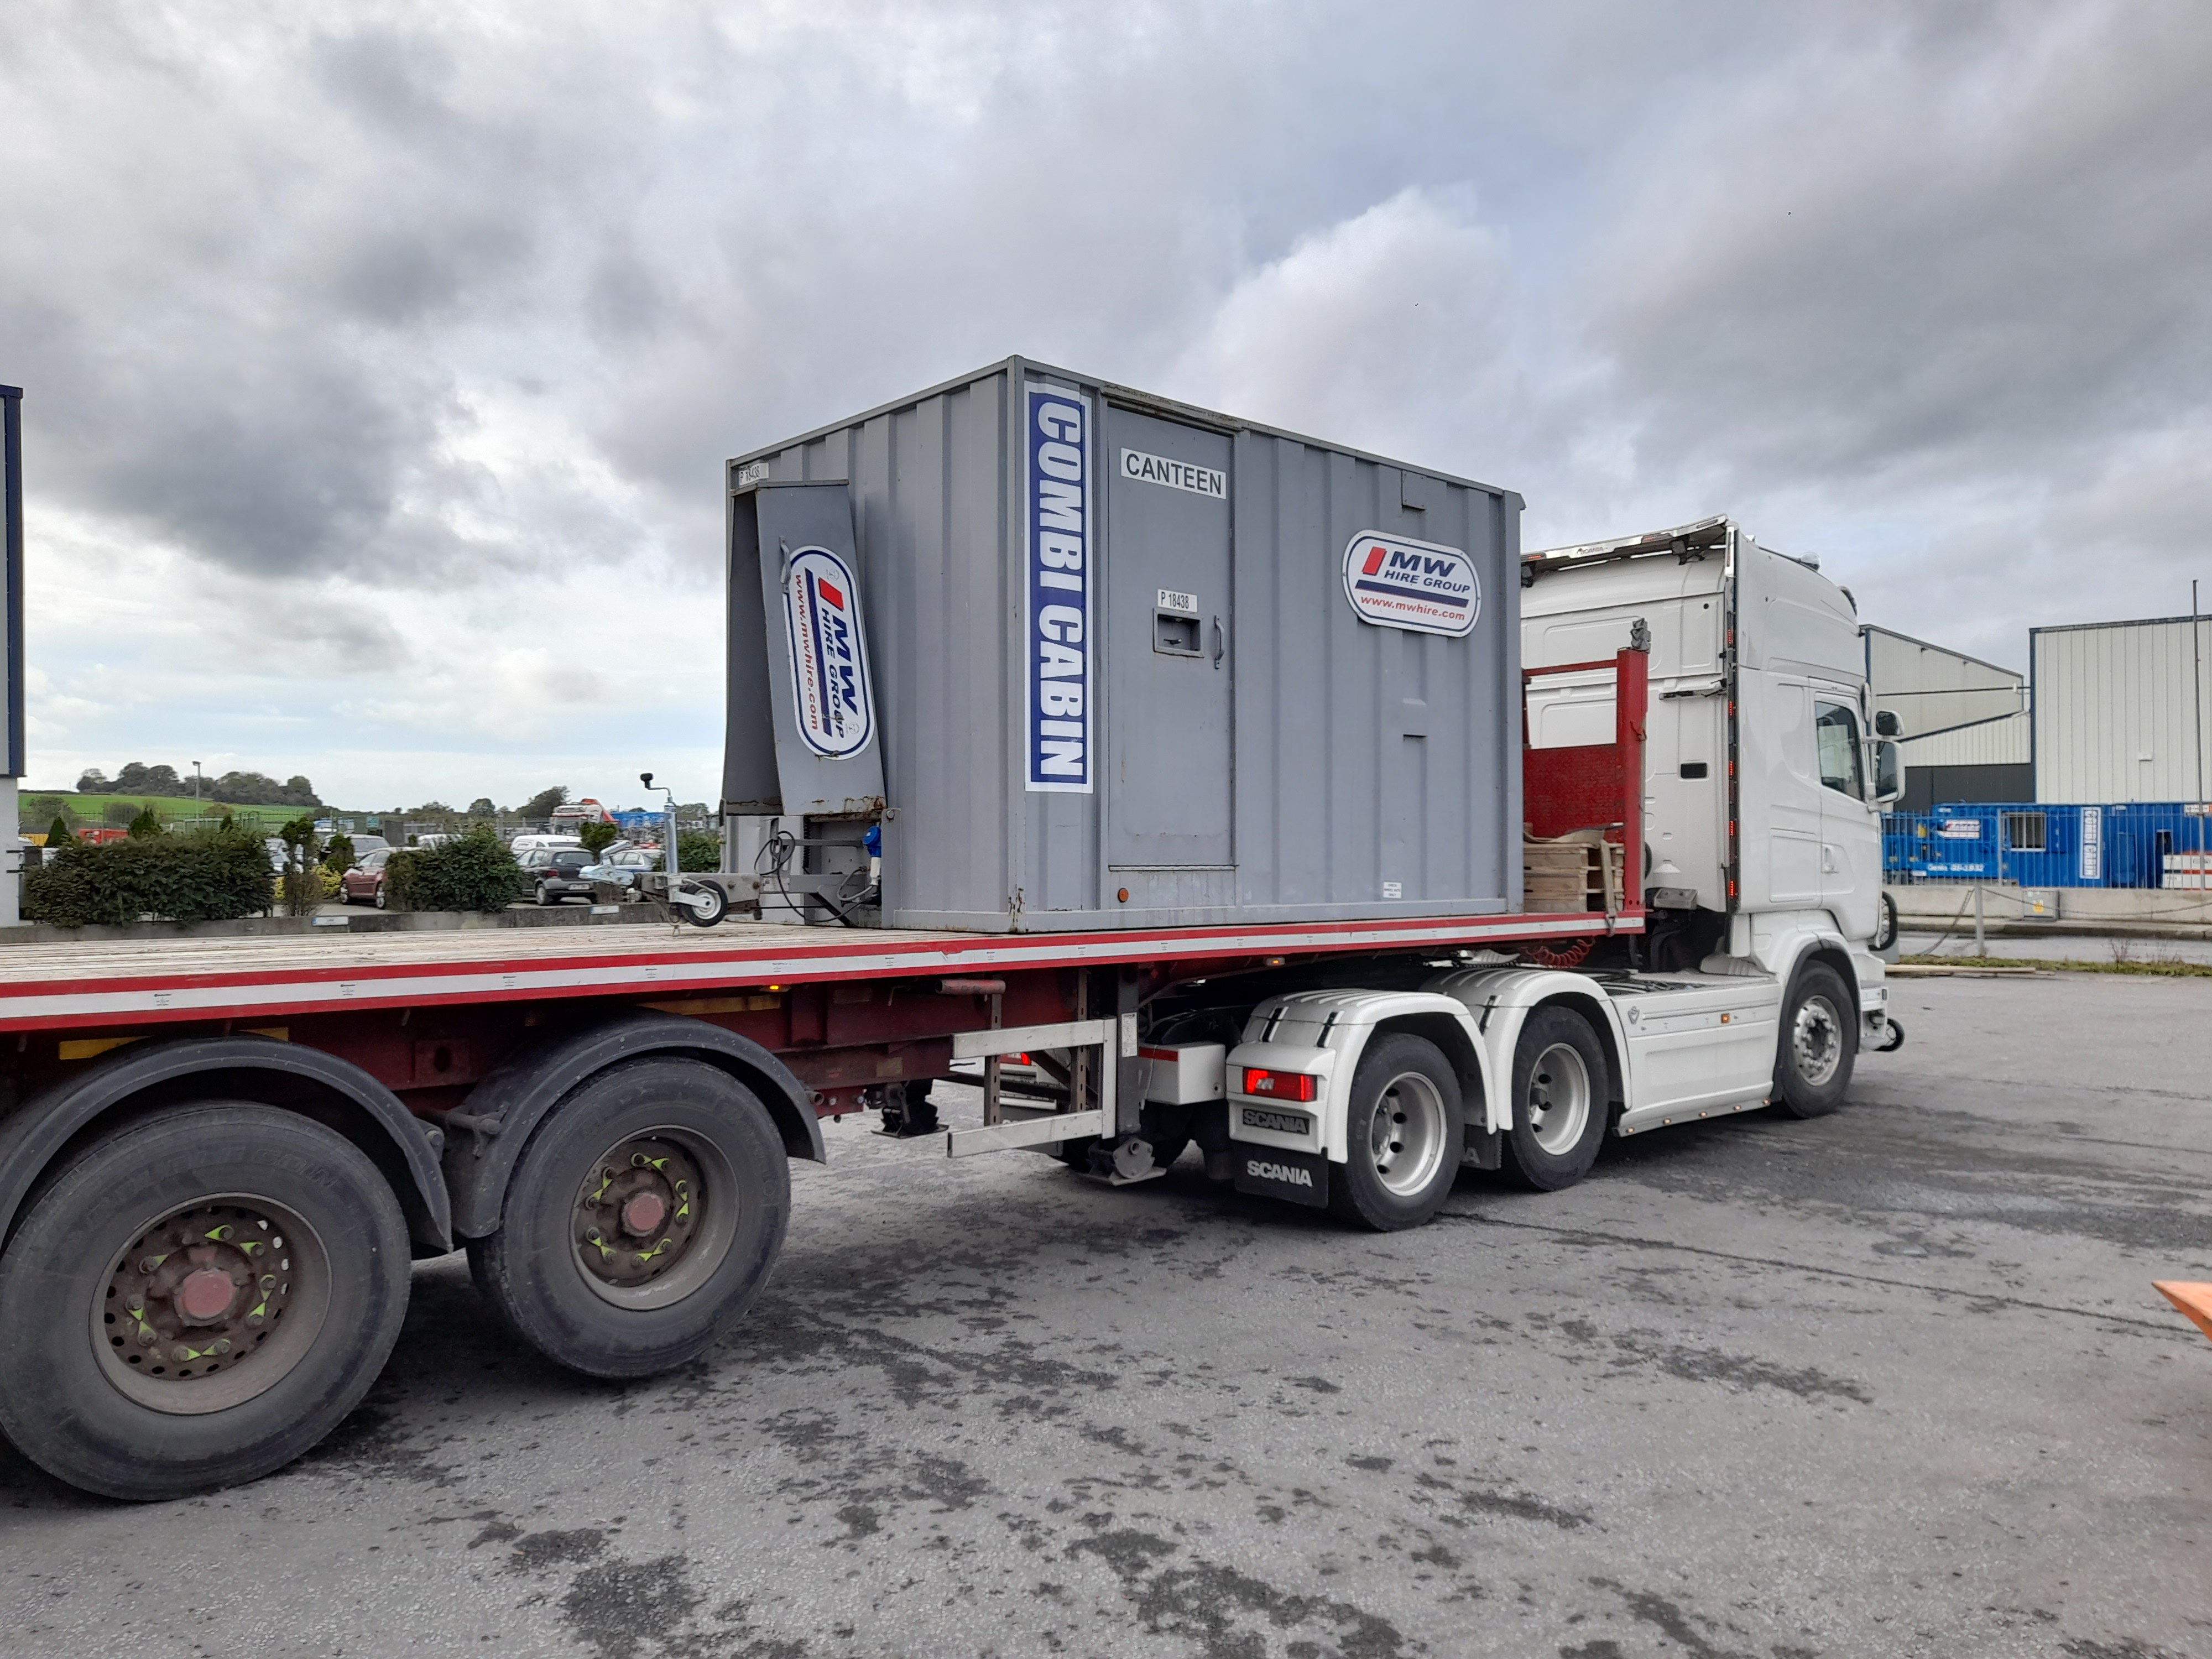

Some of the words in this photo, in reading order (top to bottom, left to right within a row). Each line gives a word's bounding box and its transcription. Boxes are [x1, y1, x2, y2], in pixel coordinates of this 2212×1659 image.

[1126, 453, 1222, 495] CANTEEN
[1037, 401, 1082, 592] COMBI
[1389, 550, 1457, 577] MW
[1384, 570, 1420, 584] HIRE
[1423, 577, 1470, 593] GROUP
[1161, 591, 1166, 606] P
[1168, 592, 1190, 609] 18438
[1360, 596, 1465, 620] www.mwhire.com
[821, 607, 836, 659] HIRE
[795, 575, 818, 731] www.mwhire.com
[832, 614, 858, 716] MW
[1039, 604, 1084, 776] CABIN
[2084, 810, 2098, 844] COMBI
[1244, 1110, 1307, 1134] SCANIA
[1246, 1160, 1313, 1187] SCANIA
